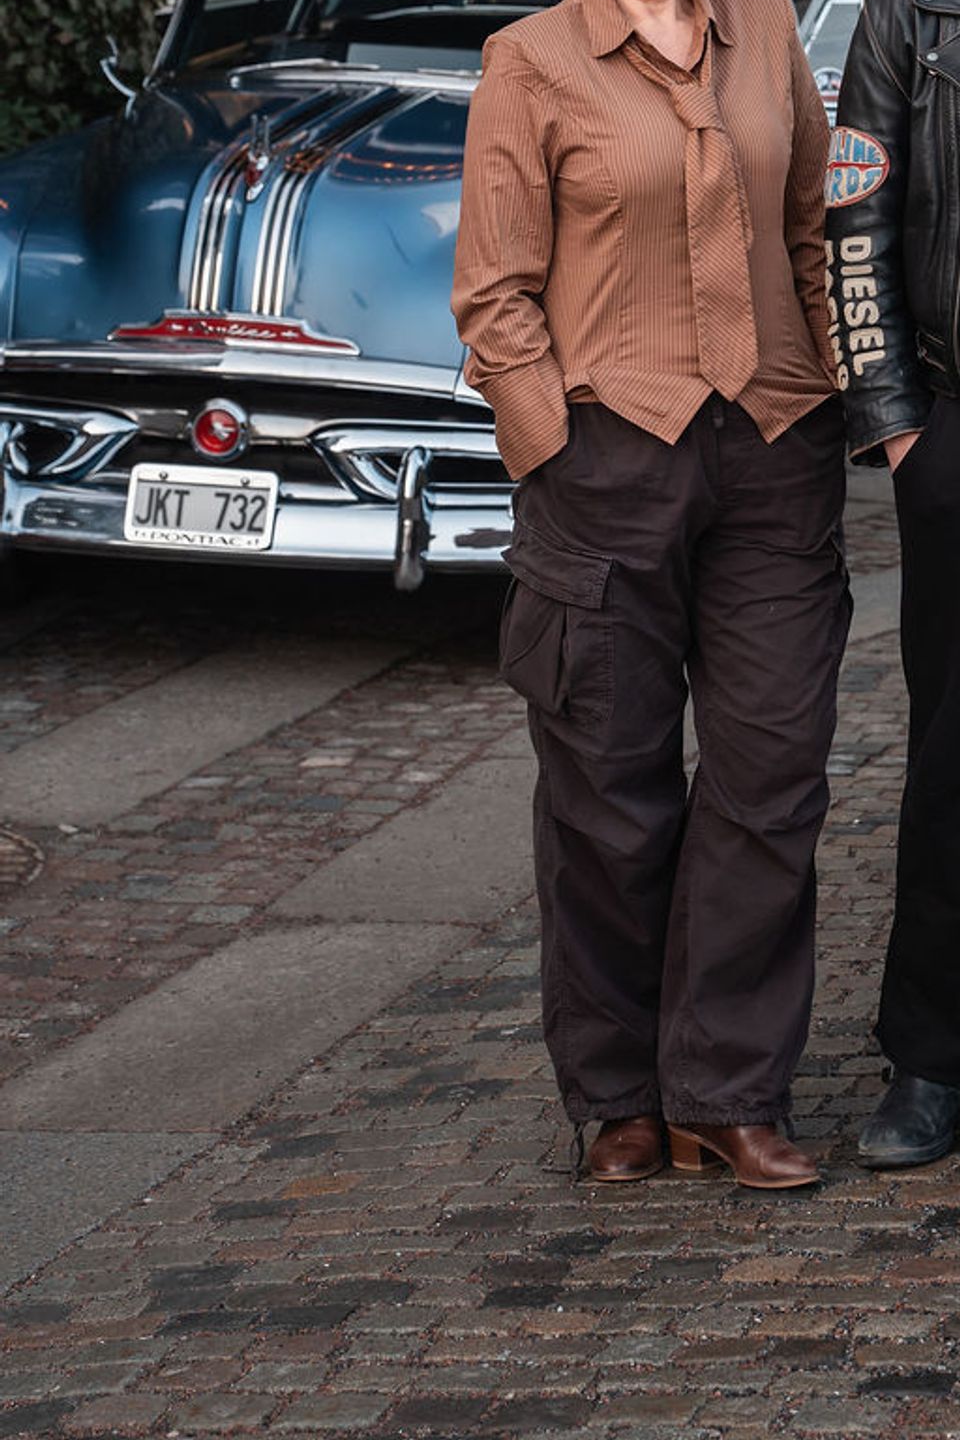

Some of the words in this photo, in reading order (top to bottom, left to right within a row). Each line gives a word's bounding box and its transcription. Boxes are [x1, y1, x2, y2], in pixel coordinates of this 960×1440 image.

[840, 236, 886, 376] DIESEL
[135, 487, 190, 528] JKT
[214, 492, 267, 533] 732
[150, 530, 239, 545] PONTIAC
